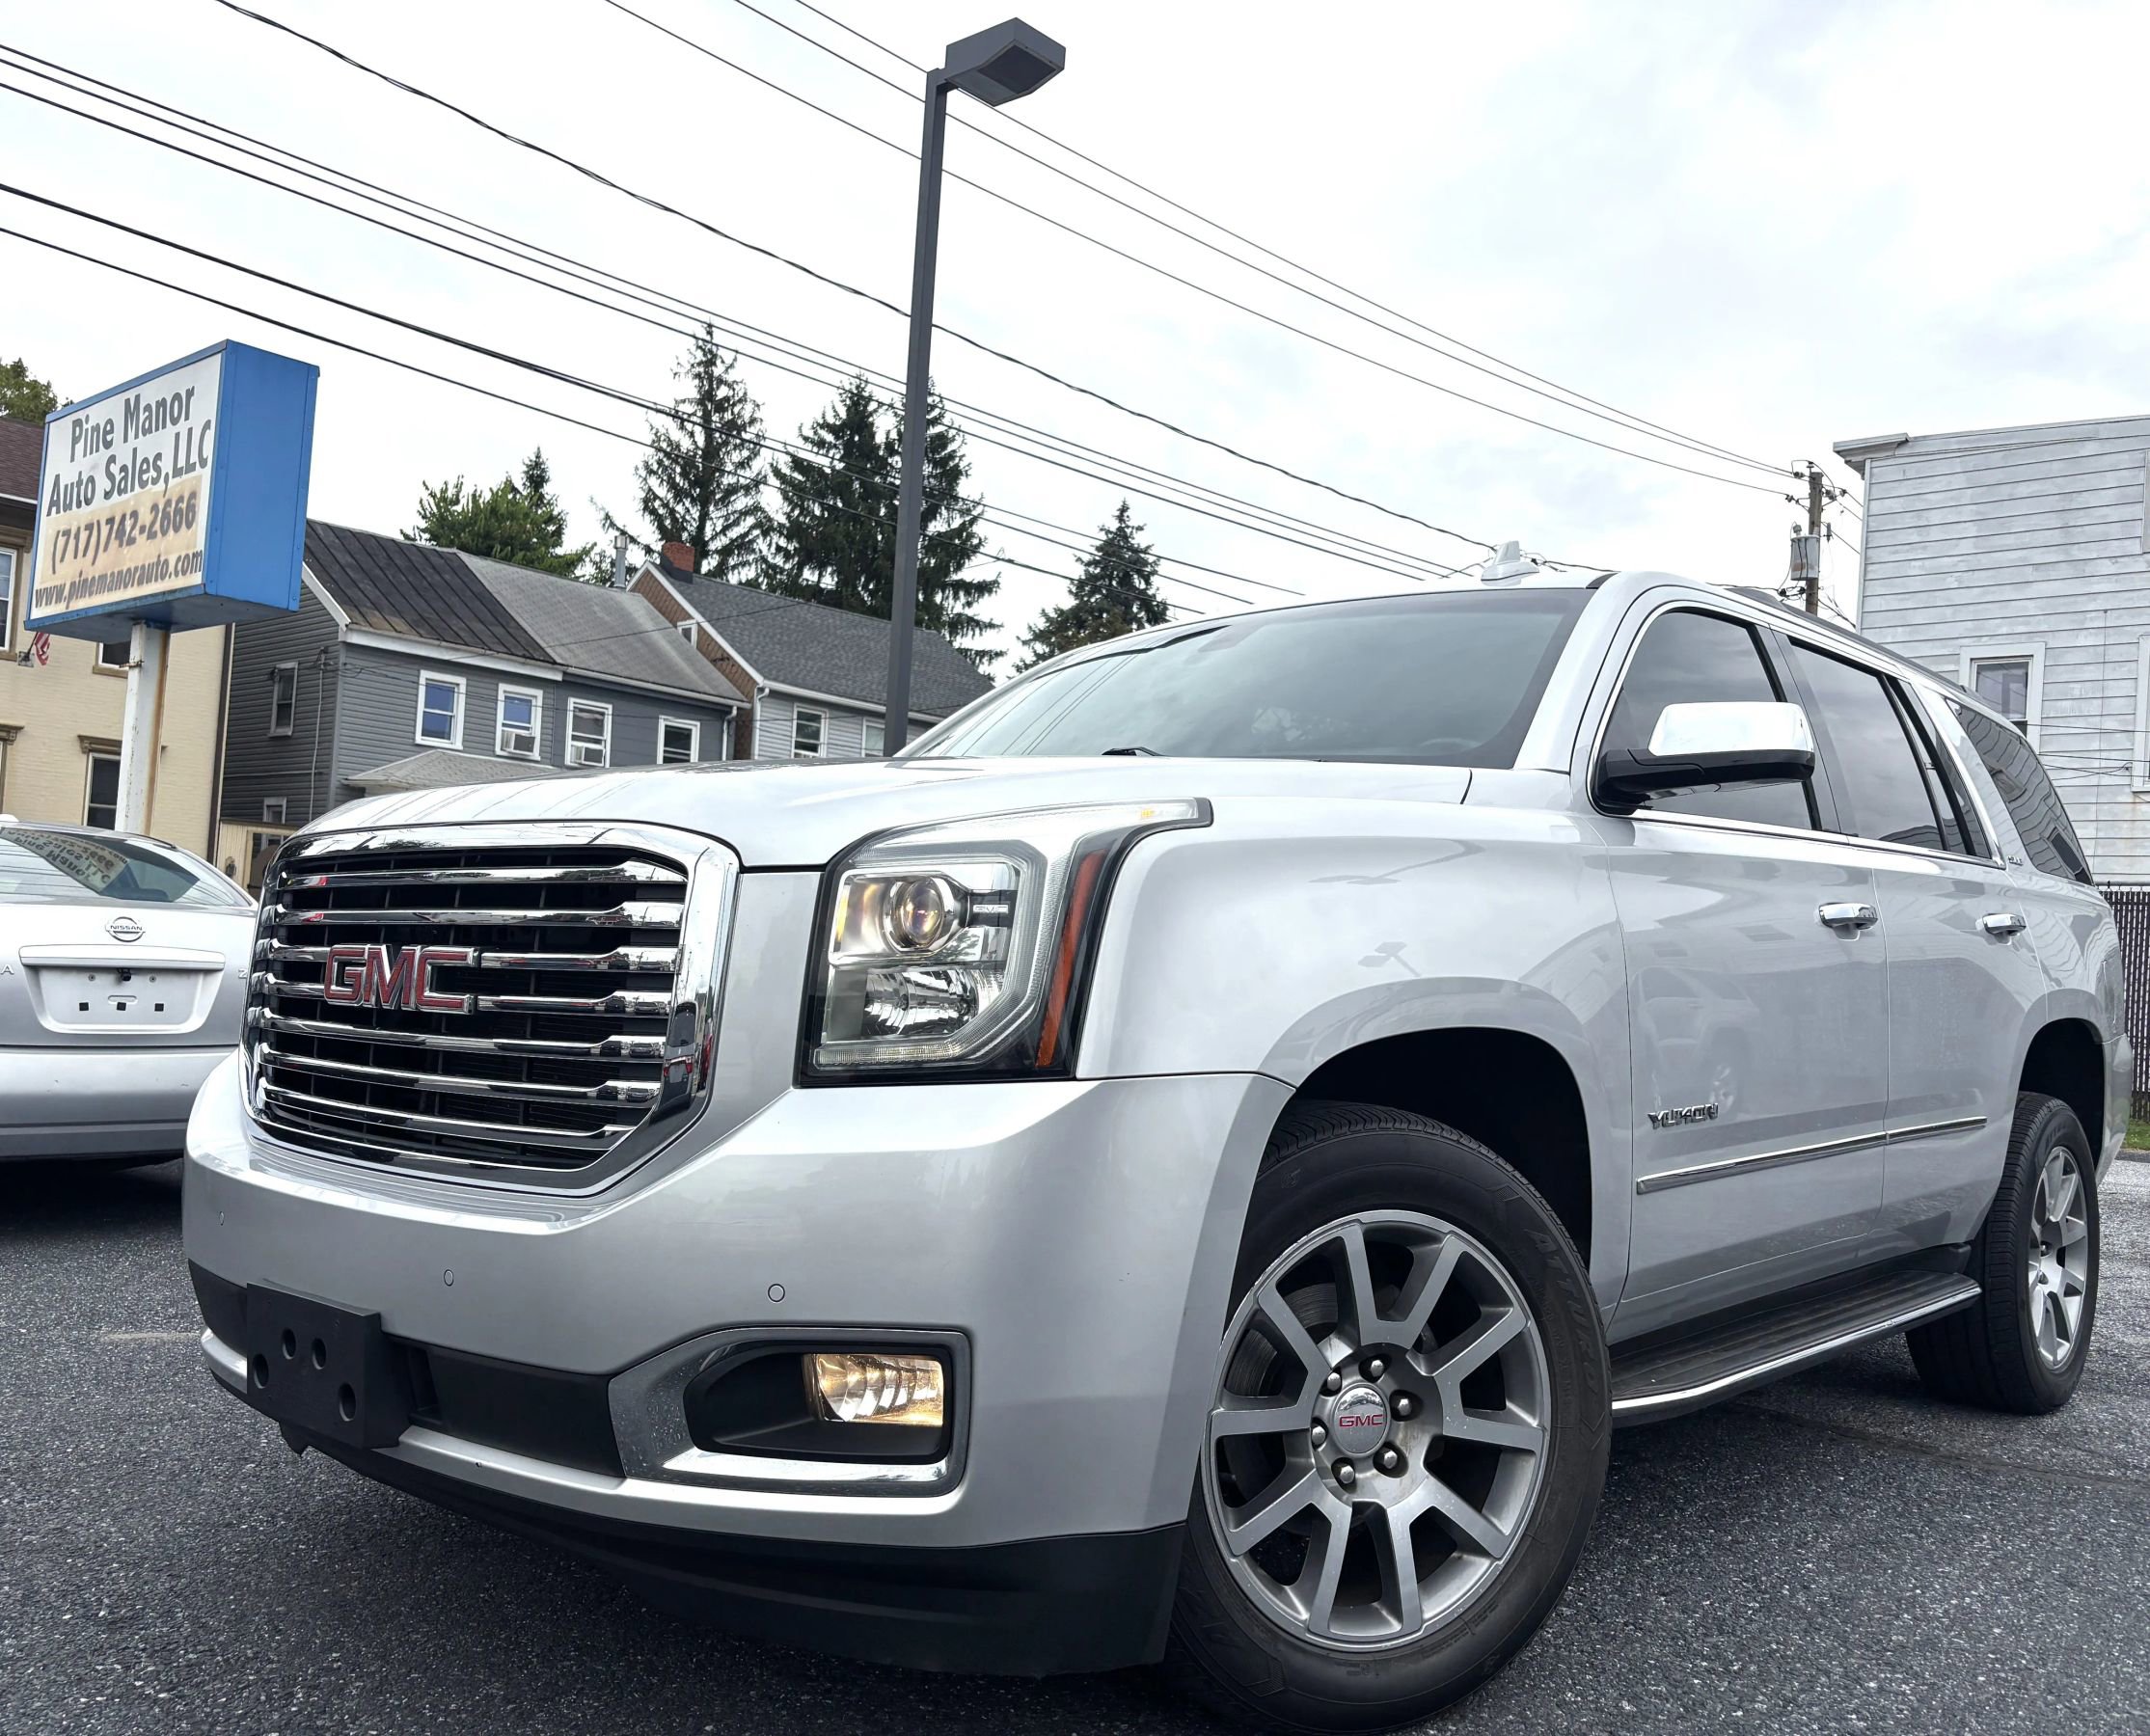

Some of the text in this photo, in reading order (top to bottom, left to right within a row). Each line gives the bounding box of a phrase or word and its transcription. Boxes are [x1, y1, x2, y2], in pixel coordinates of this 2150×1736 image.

[69, 385, 196, 463] Pine Manor
[46, 473, 96, 517] Auto
[51, 490, 198, 575] (717)742-2666
[35, 548, 204, 610] www.pinemanorauto.com
[323, 943, 479, 1015] GMC
[1647, 1102, 1719, 1130] YUKON
[1339, 1414, 1384, 1427] GMC
